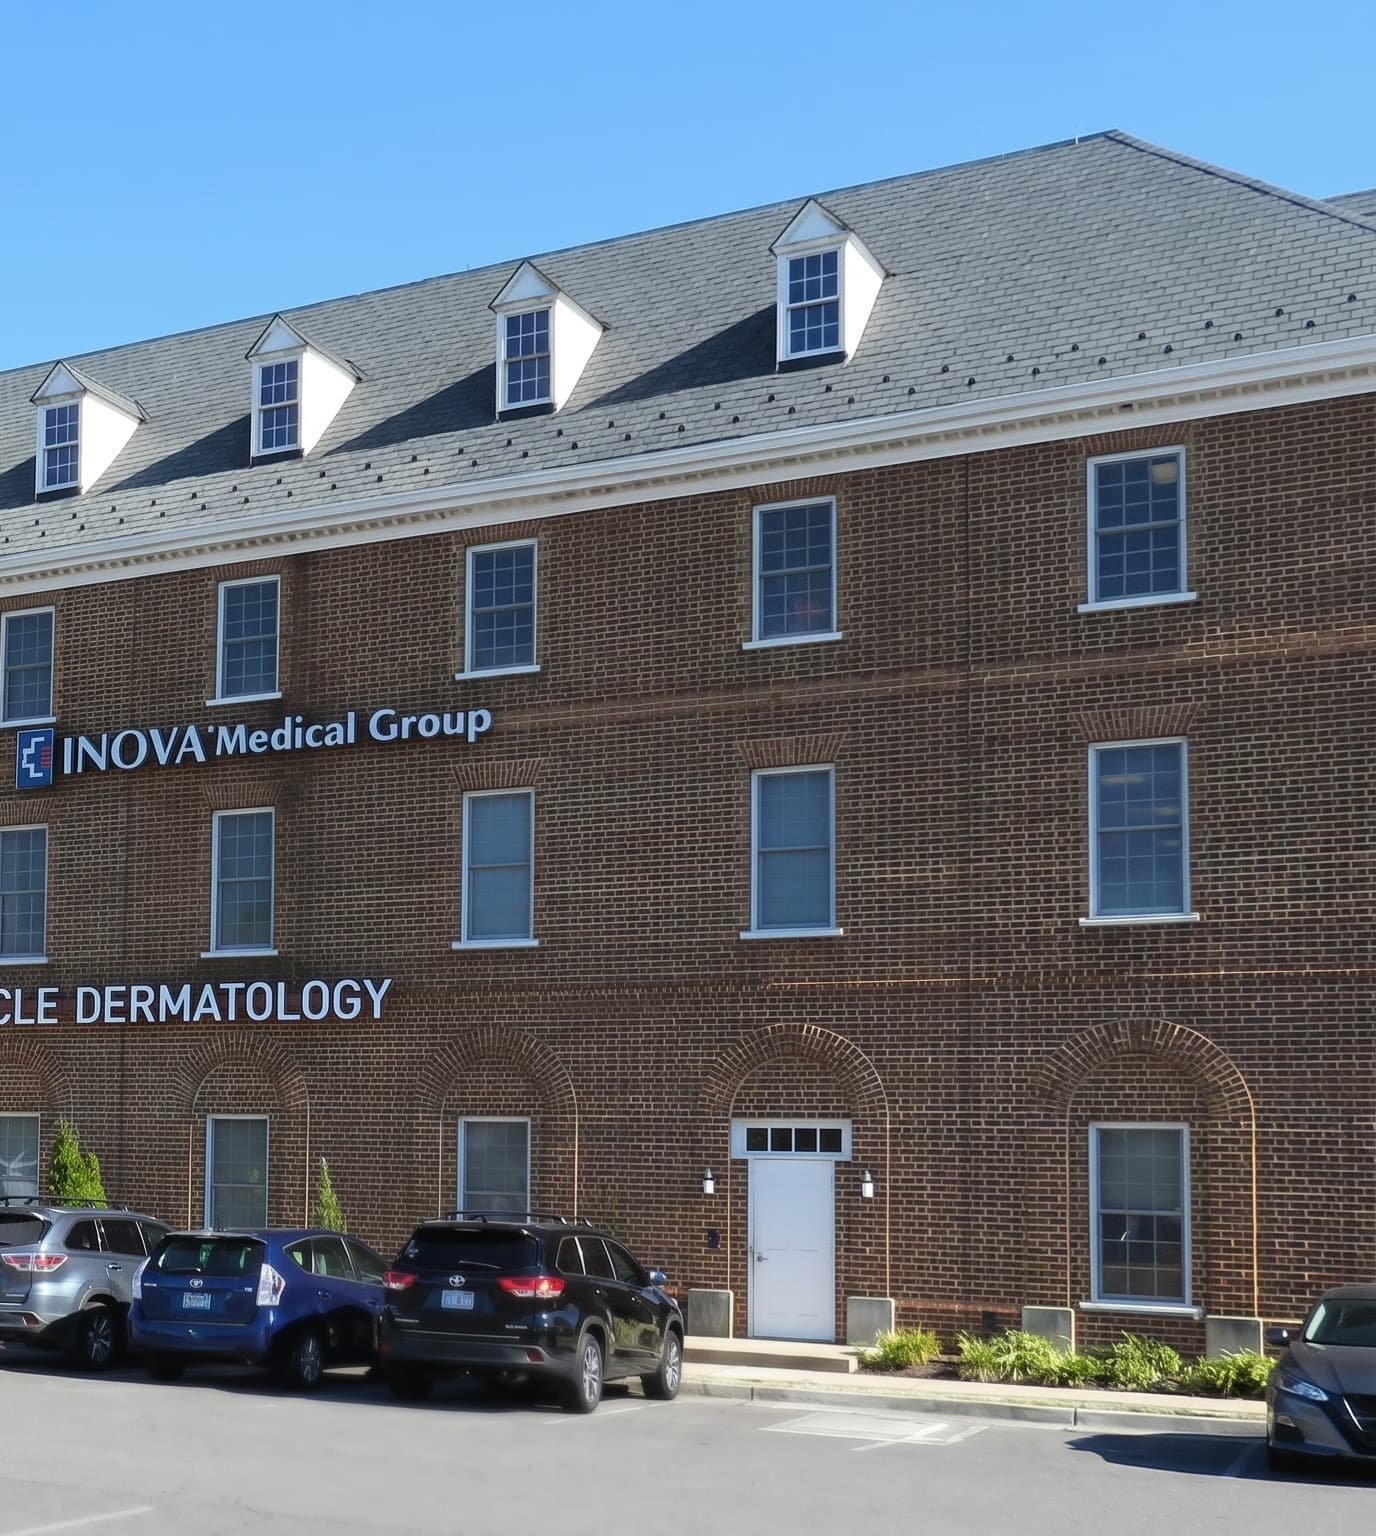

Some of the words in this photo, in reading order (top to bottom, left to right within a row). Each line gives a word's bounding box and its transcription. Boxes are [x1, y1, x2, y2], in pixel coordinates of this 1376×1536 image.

[62, 725, 208, 774] INOVA
[215, 711, 356, 756] Medical
[368, 708, 492, 743] Group
[76, 978, 392, 1024] DERMATOLOGY
